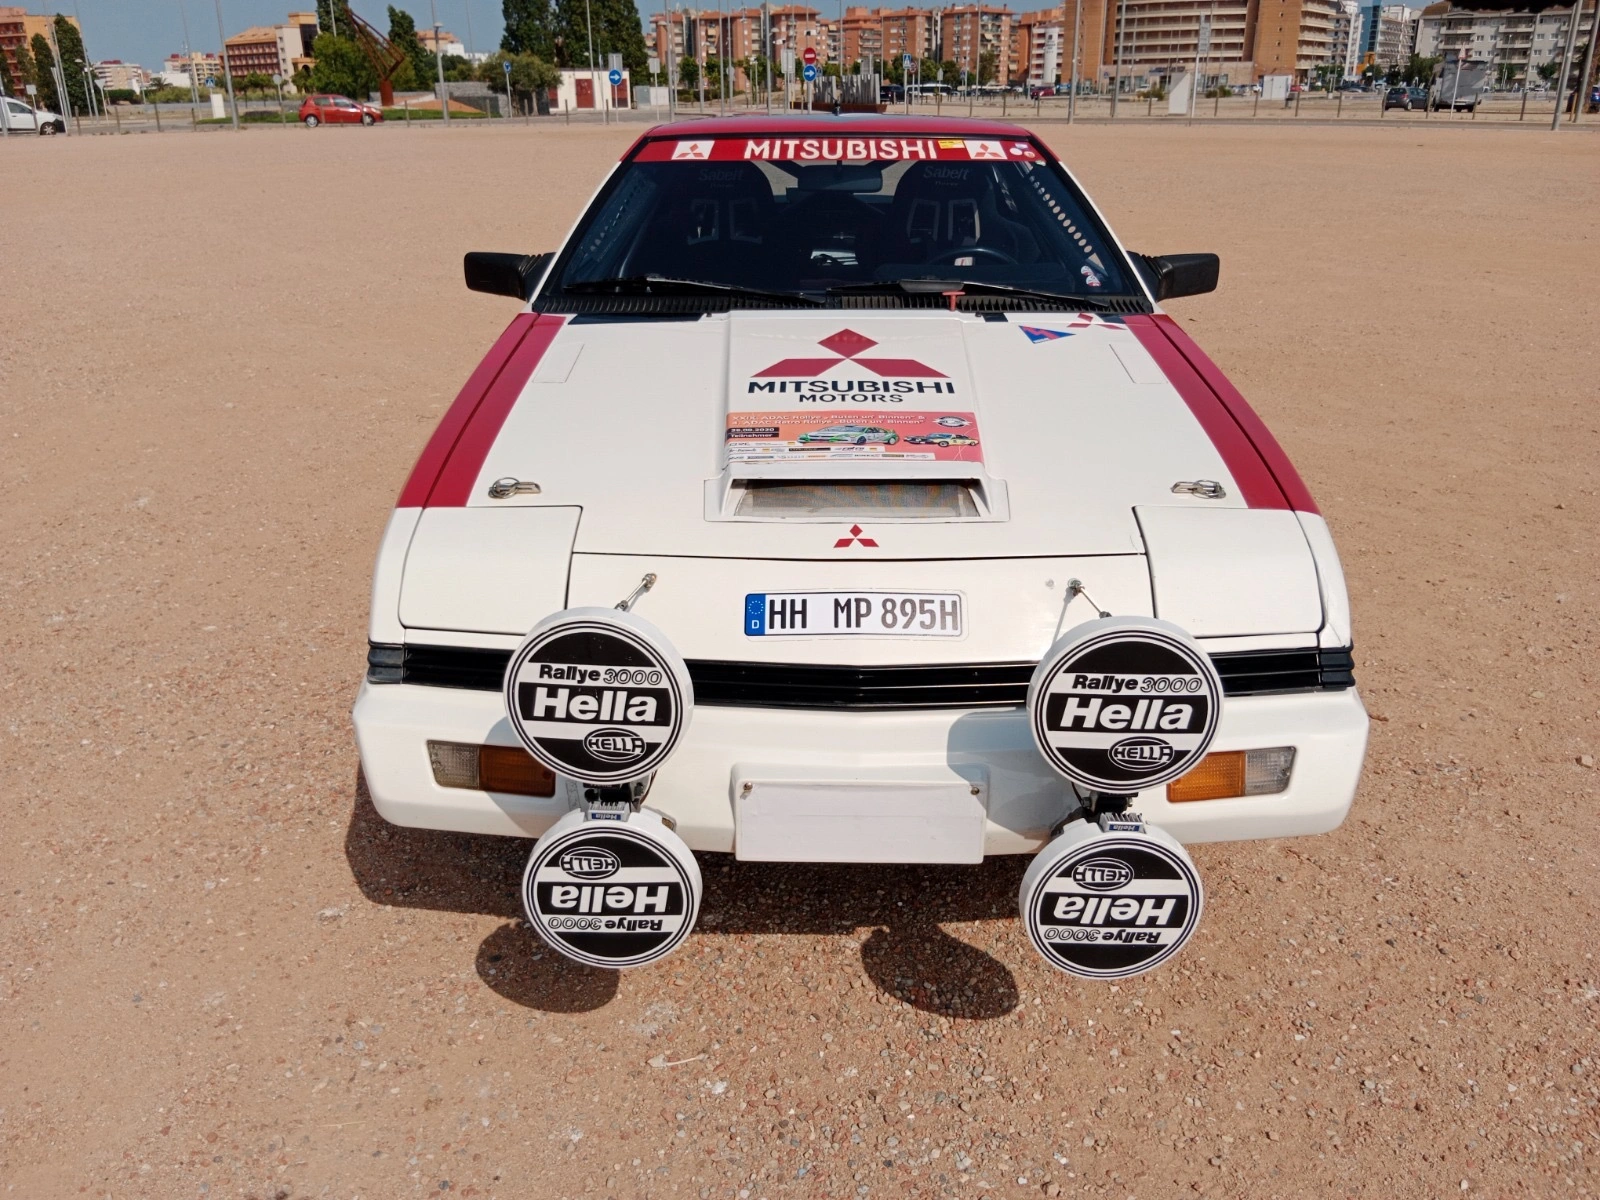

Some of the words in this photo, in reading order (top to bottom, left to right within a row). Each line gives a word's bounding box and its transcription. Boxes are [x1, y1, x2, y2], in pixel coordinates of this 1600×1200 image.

[743, 138, 938, 160] MITSUBISHI
[923, 165, 970, 180] Sabelt
[747, 380, 956, 394] MITSUBISHI
[799, 394, 904, 403] MOTORS
[768, 598, 807, 629] HH
[833, 597, 872, 628] MP
[880, 598, 959, 631] 895H
[751, 619, 760, 629] D
[539, 664, 601, 684] Rallye
[602, 668, 663, 685] 3000
[1072, 674, 1139, 693] Rallye
[1140, 677, 1203, 693] 3000
[533, 686, 658, 722] Hella
[1059, 697, 1194, 730] Hella
[587, 736, 645, 755] HELLA
[1112, 745, 1174, 762] HELLA
[560, 855, 617, 872] HELLA
[1072, 866, 1131, 883] HELLA
[551, 885, 670, 913] Hella
[1053, 895, 1177, 925] Hella
[548, 916, 602, 930] 3000
[604, 917, 664, 931] Rallye
[1043, 927, 1101, 941] 3000
[1101, 928, 1162, 944] Rallye
